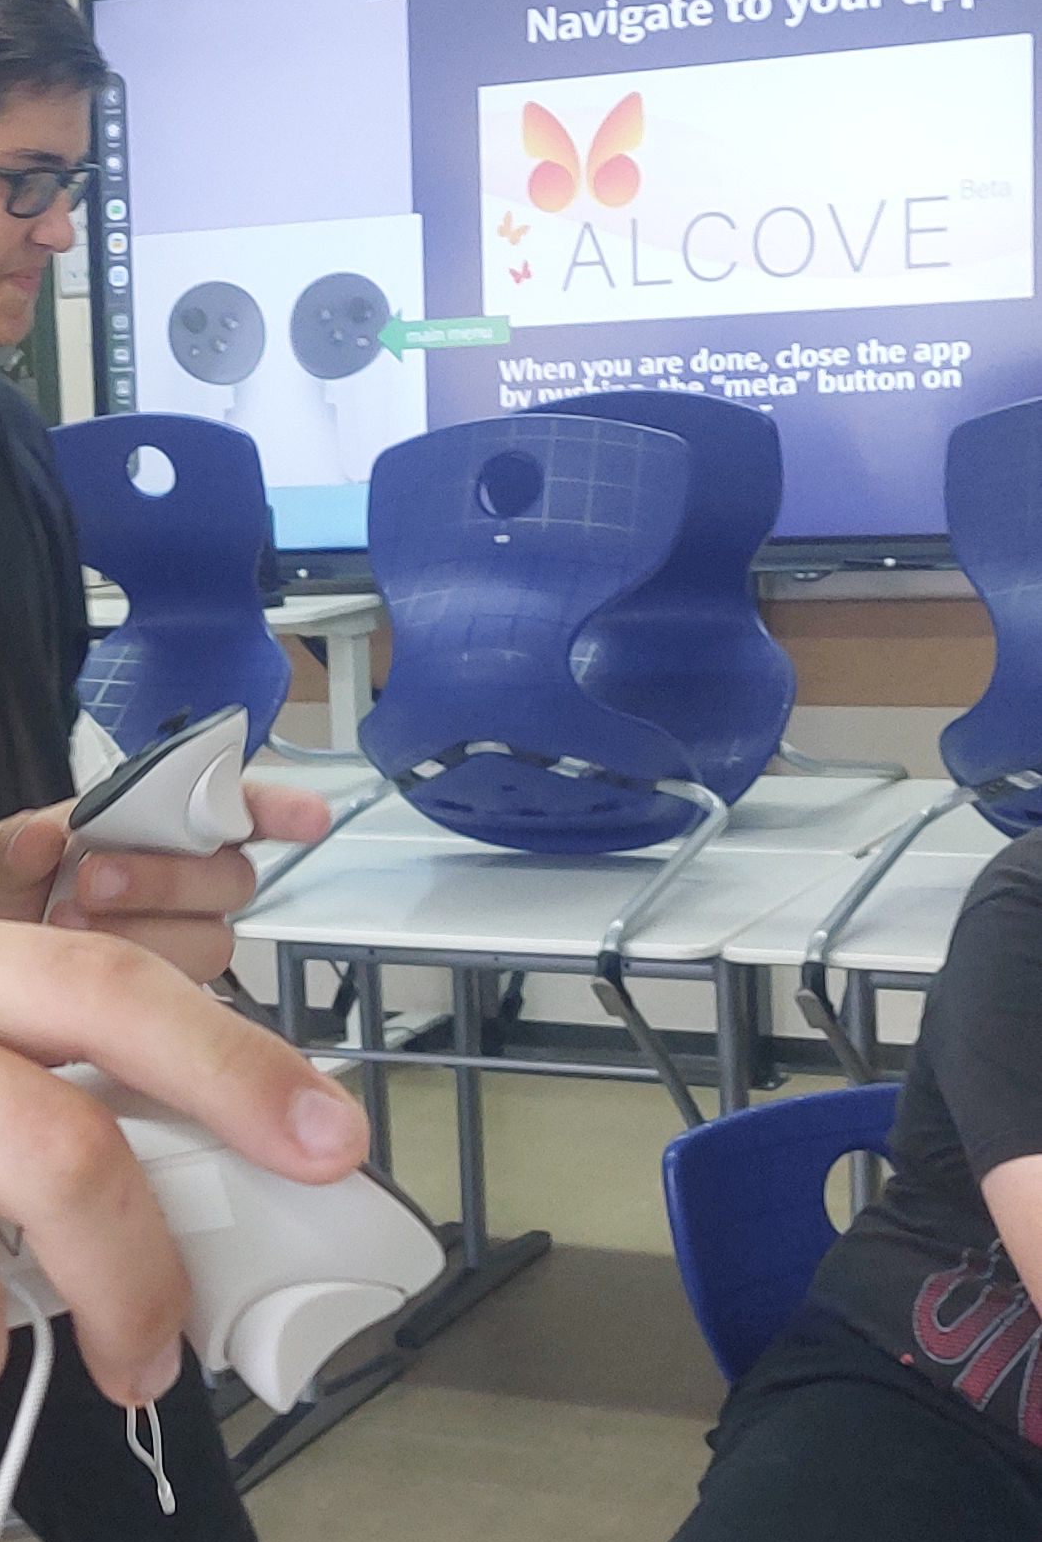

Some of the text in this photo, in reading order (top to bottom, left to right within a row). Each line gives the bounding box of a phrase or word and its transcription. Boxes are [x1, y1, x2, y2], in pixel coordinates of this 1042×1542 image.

[960, 178, 1013, 201] Beta
[562, 195, 951, 292] ALCOVE
[498, 338, 971, 383] When you are done, close the app
[498, 383, 532, 408] by
[816, 368, 916, 394] button
[921, 368, 962, 389] on
